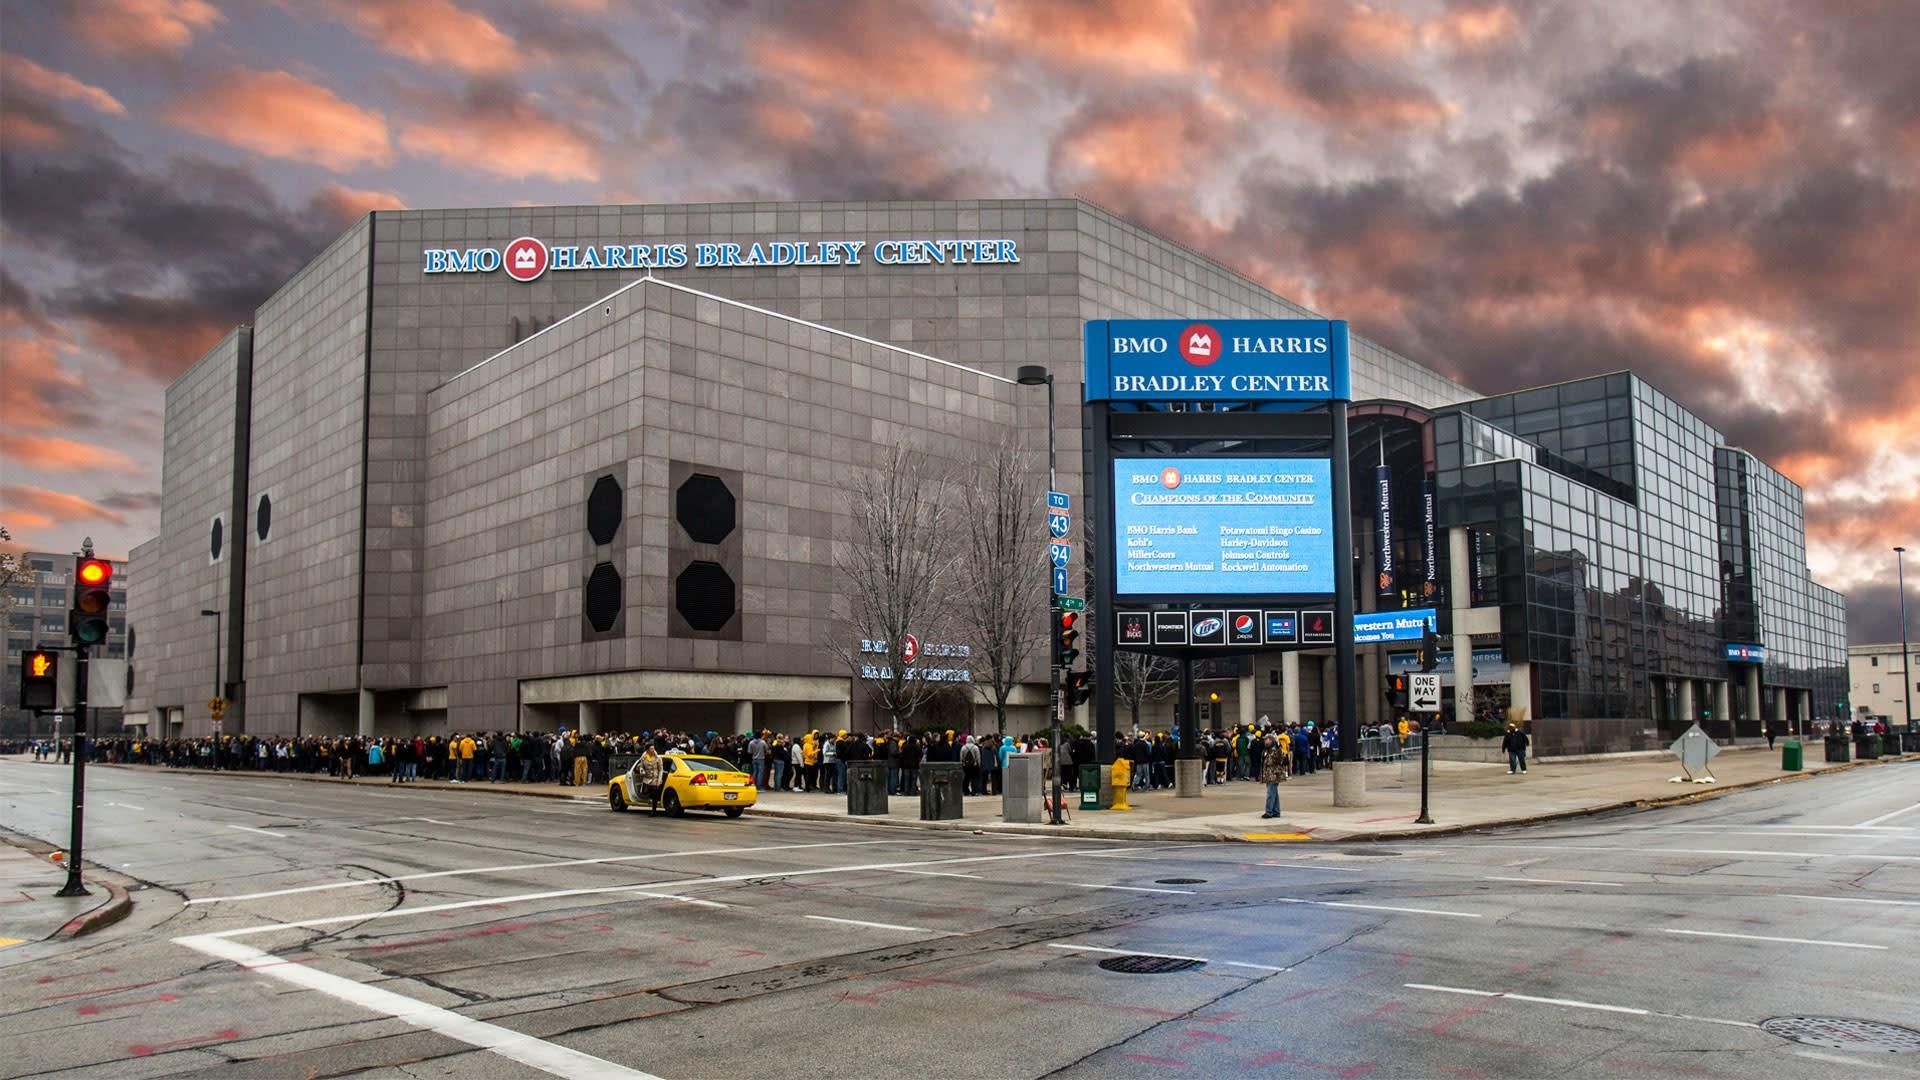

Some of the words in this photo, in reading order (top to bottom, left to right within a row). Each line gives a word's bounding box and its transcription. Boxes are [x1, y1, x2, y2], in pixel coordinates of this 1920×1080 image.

[424, 248, 500, 273] BMO
[550, 243, 688, 270] HARRIS
[695, 240, 866, 268] BRADLEY
[874, 239, 1020, 265] CENTER
[1112, 337, 1168, 353] BMO
[1232, 337, 1328, 353] HARRIS
[1114, 375, 1225, 392] BRADLEY
[1231, 375, 1330, 392] CENTER
[1132, 474, 1158, 484] BMO
[1183, 474, 1222, 484] HARRIS
[1226, 474, 1273, 484] BRADLEY
[1274, 474, 1314, 484] CENTER
[1053, 495, 1064, 505] TO
[1131, 492, 1200, 505] CHAMPIONS
[1203, 494, 1219, 503] OF
[1221, 494, 1243, 503] THE
[1245, 492, 1315, 504] COMMUNITY
[1380, 479, 1389, 511] Mutual
[1424, 493, 1433, 523] Mutual
[1051, 515, 1068, 532] 43
[1127, 525, 1148, 535] BMO
[1149, 525, 1176, 535] Harris
[1177, 525, 1198, 535] Bank
[1220, 526, 1268, 536] Potawatomi
[1270, 526, 1293, 537] Bingo
[1294, 526, 1322, 536] Casino
[1127, 538, 1153, 547] Kohl's
[1220, 538, 1289, 549] Harley-Davidson
[1382, 511, 1392, 572] Northwestern
[1051, 545, 1068, 562] 94
[1127, 550, 1176, 560] MillerCoors
[1222, 551, 1254, 561] Johnson
[1255, 550, 1290, 560] Controls
[1426, 524, 1435, 580] Northwestern
[1127, 562, 1184, 572] Northwestern
[1184, 562, 1215, 572] Mutual
[1221, 562, 1260, 572] Rockwell
[1261, 562, 1309, 572] Automation
[1354, 621, 1394, 632] western
[1395, 615, 1434, 629] Mutul
[1381, 632, 1395, 640] You
[1415, 676, 1435, 686] ONE
[1414, 687, 1436, 696] WAY
